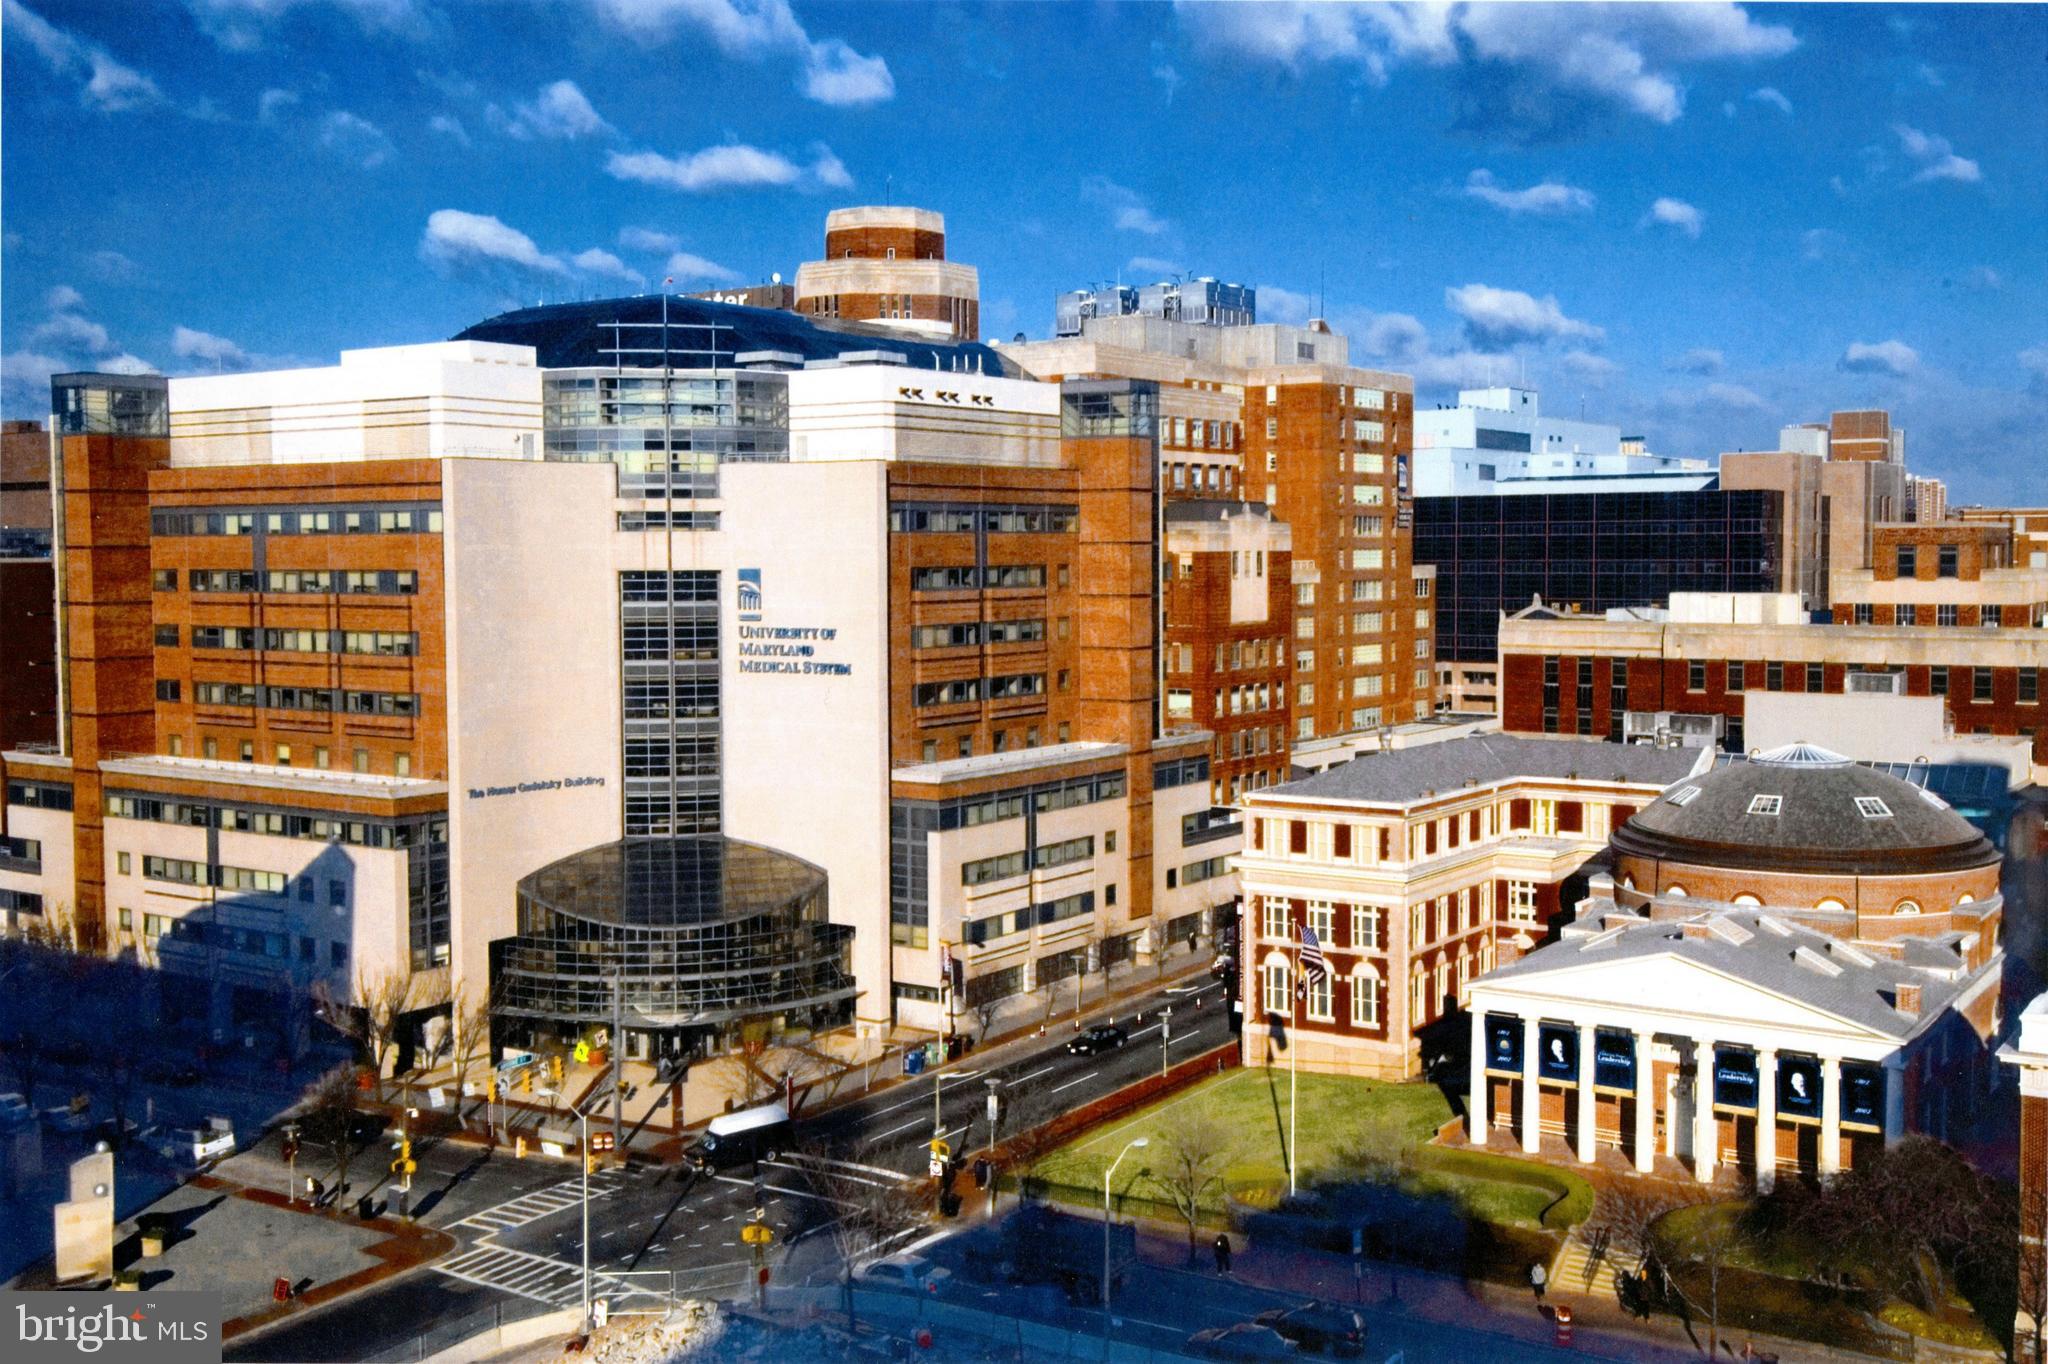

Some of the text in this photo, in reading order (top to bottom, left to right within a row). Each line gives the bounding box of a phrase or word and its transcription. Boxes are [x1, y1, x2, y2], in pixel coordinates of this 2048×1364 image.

[820, 628, 837, 641] OF
[739, 660, 801, 674] MEDICAL
[564, 776, 605, 788] Building
